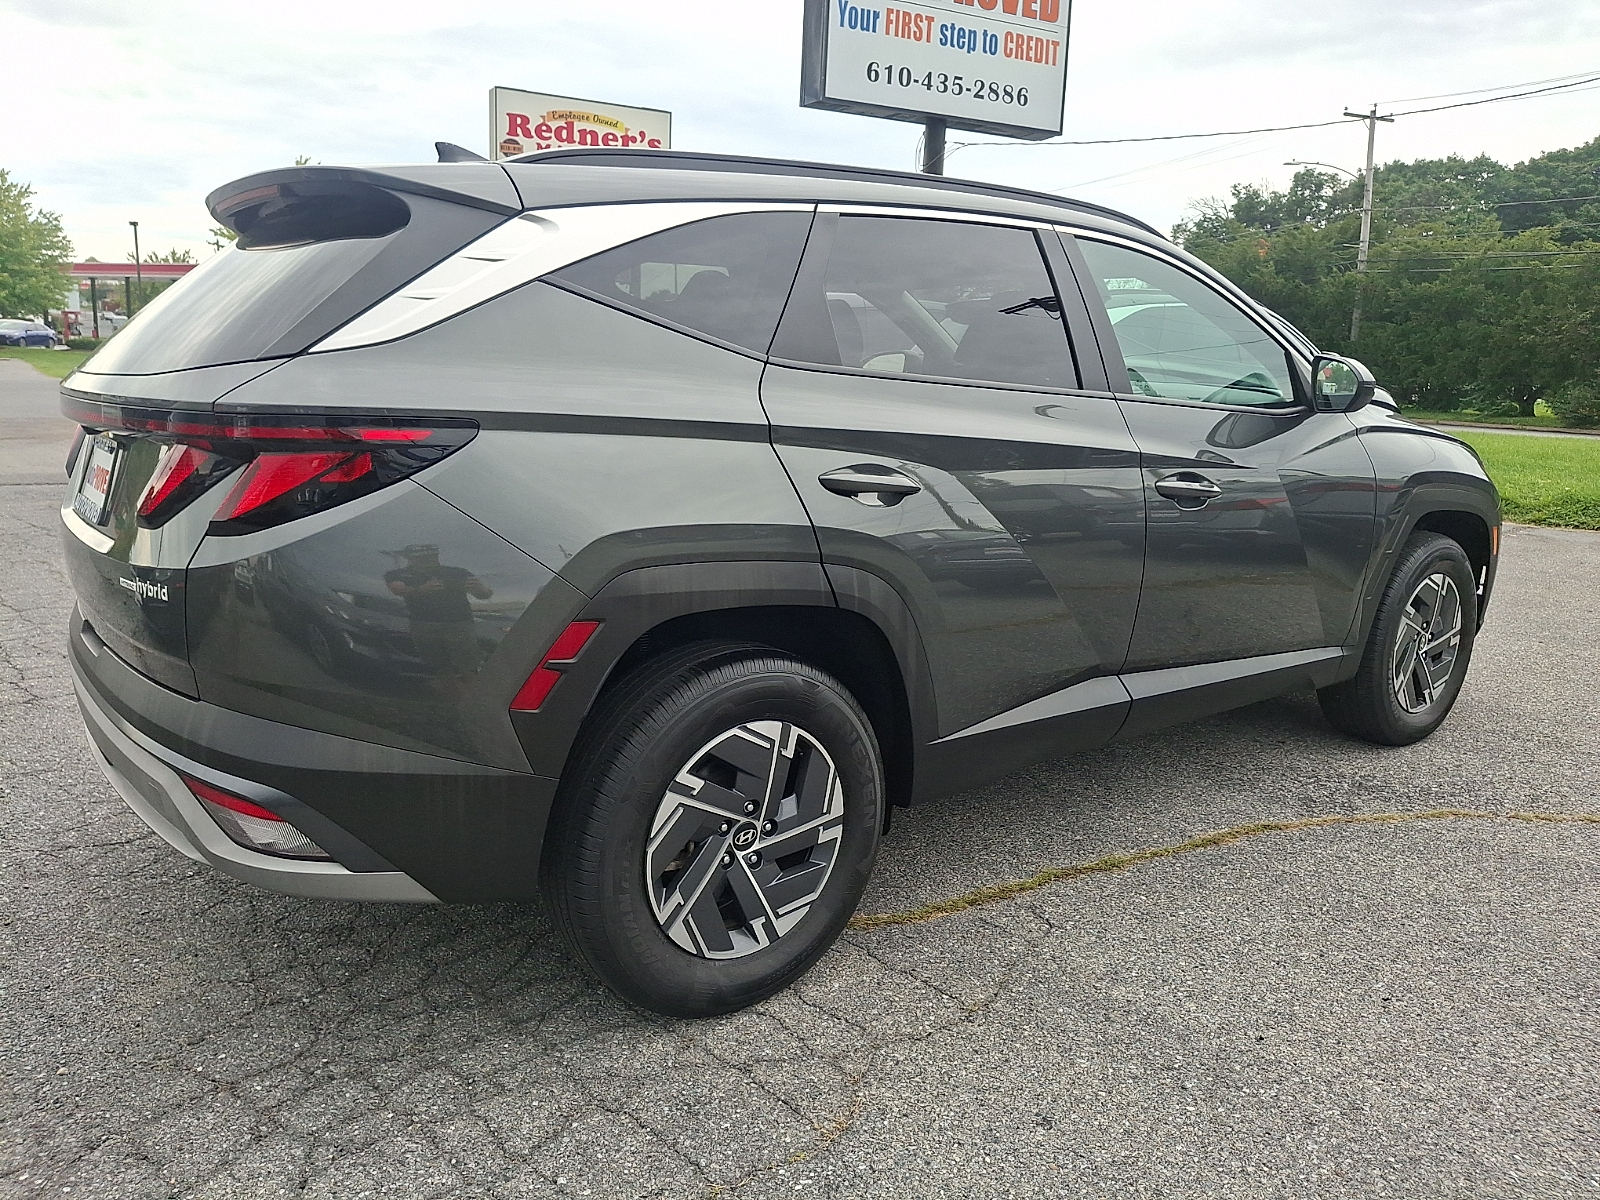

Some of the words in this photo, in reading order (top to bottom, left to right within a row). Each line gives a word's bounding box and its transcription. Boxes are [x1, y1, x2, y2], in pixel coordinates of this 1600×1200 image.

[838, 0, 880, 33] Your
[885, 8, 935, 43] FIRST
[939, 23, 978, 54] step
[982, 29, 999, 56] to
[1003, 31, 1060, 66] CREDIT
[866, 61, 1029, 106] 610-435-2886
[506, 112, 662, 149] Redner's
[552, 110, 591, 122] Employee
[592, 114, 619, 128] Owned
[136, 576, 169, 602] hybrid
[843, 721, 876, 827] NEXEN
